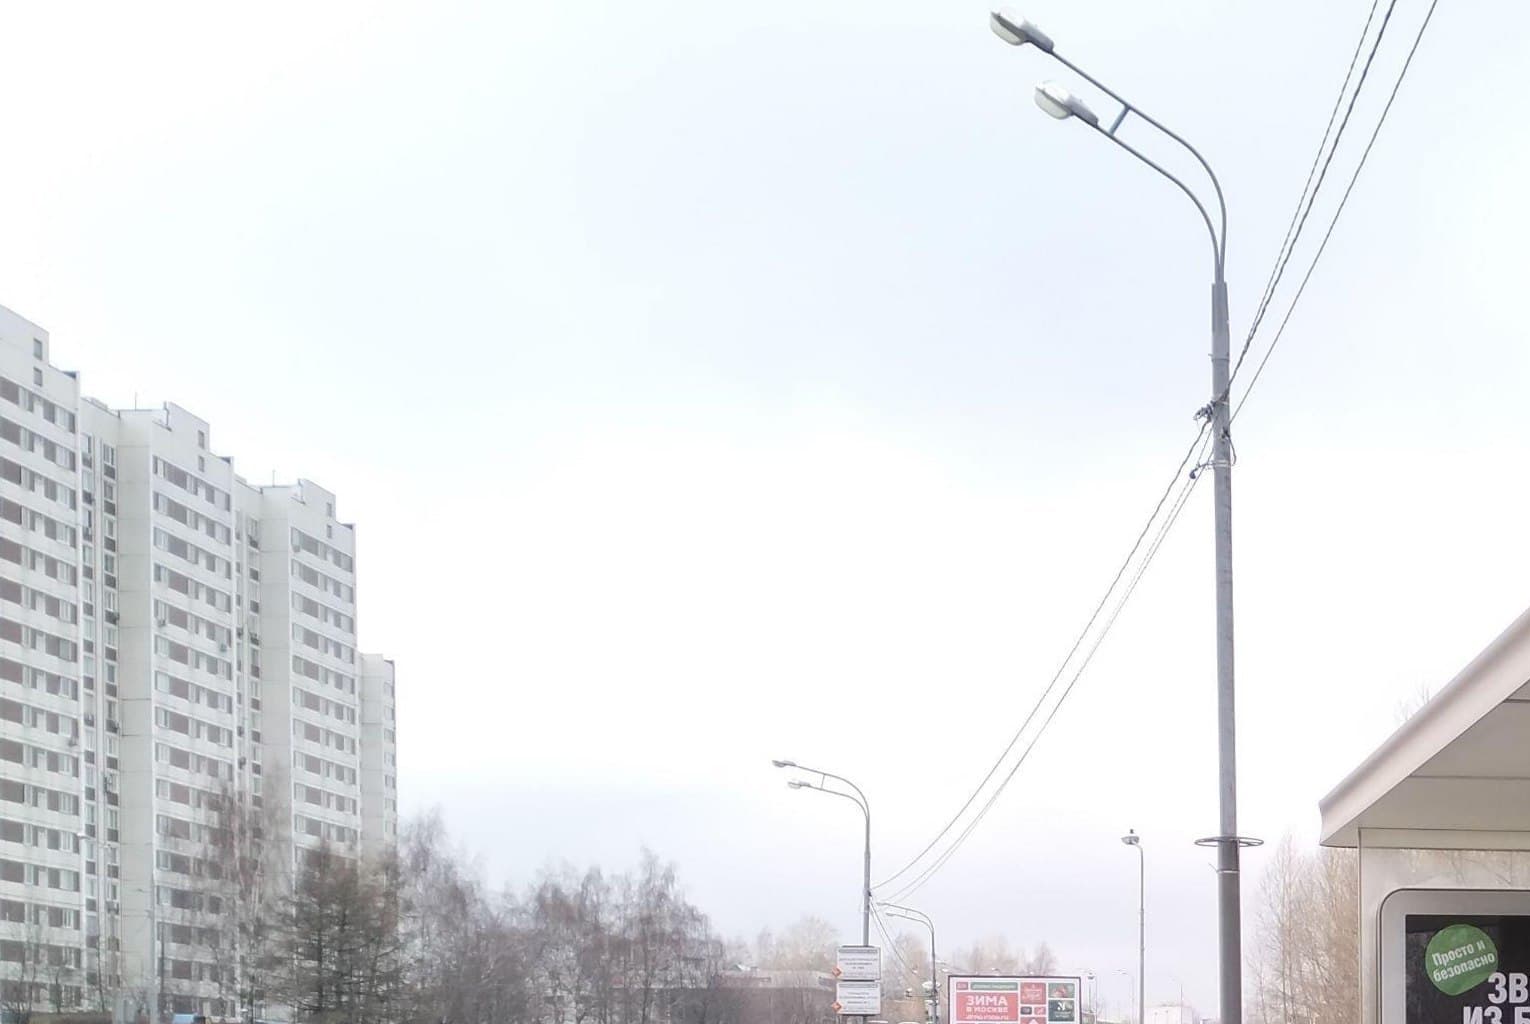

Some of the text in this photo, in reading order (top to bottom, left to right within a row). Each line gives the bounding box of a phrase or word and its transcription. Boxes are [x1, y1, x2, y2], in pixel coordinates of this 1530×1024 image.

[1432, 940, 1486, 966] Просто и
[1433, 953, 1496, 982] безопасно
[966, 995, 1008, 1006] ЗИМА
